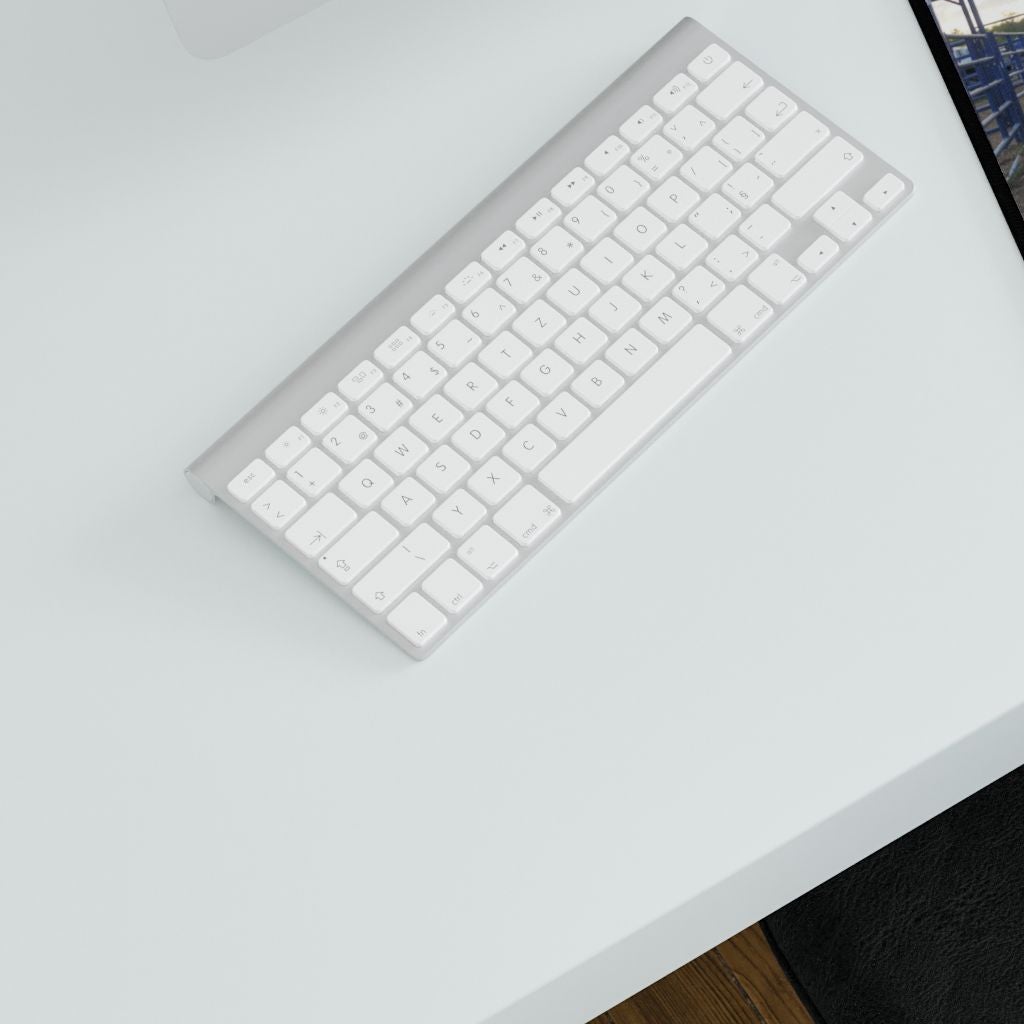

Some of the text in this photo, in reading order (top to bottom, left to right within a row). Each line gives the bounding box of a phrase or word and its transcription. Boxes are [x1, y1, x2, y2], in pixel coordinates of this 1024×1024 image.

[668, 193, 679, 203] P
[570, 215, 581, 225] 9
[674, 241, 686, 250] L
[537, 246, 547, 257] 8
[640, 270, 652, 281] K
[502, 277, 513, 288] 7
[567, 285, 581, 296] U
[608, 301, 619, 312] J
[470, 309, 480, 319] 6
[657, 312, 672, 325] M
[534, 317, 547, 328] Z
[572, 332, 586, 344] H
[435, 340, 445, 351] 5
[624, 344, 638, 355] N
[500, 348, 511, 359] T
[539, 364, 551, 375] G
[401, 371, 412, 382] 4
[591, 377, 602, 387] B
[466, 381, 478, 391] R
[504, 396, 515, 407] F
[365, 404, 376, 415] 3
[556, 407, 567, 417] V
[431, 413, 443, 423] E
[469, 429, 482, 440] D
[330, 436, 341, 447] 2
[523, 440, 534, 450] C
[394, 444, 409, 456] W
[435, 462, 447, 472] S
[361, 478, 374, 488] Q
[487, 473, 500, 485] X
[401, 495, 413, 506] A
[451, 505, 463, 515] Y
